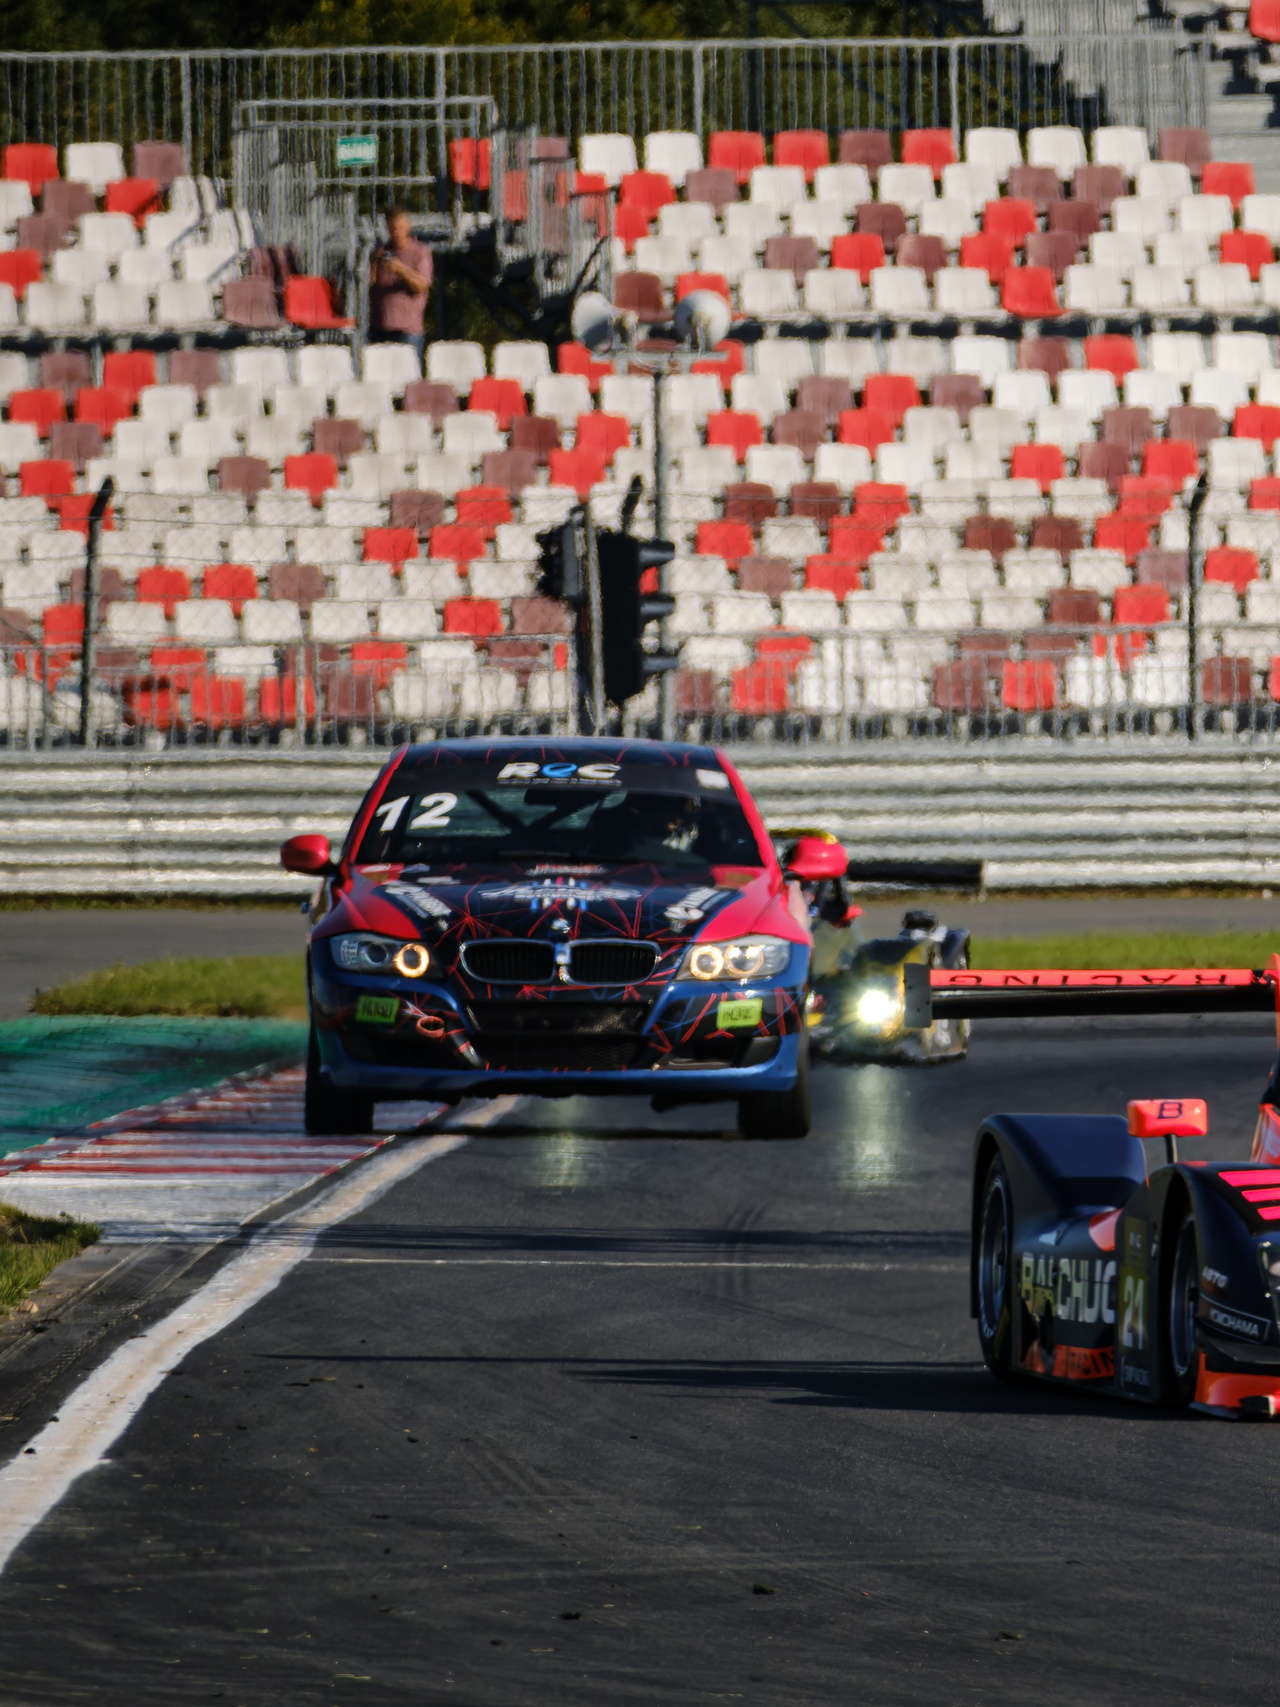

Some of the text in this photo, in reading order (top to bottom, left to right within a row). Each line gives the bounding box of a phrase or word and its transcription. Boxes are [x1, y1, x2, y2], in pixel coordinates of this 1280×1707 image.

[375, 792, 458, 832] 12
[949, 974, 1227, 985] RACING
[1157, 1102, 1183, 1119] B
[1122, 1274, 1145, 1350] 21
[1209, 1307, 1260, 1338] YOKOHAMA
